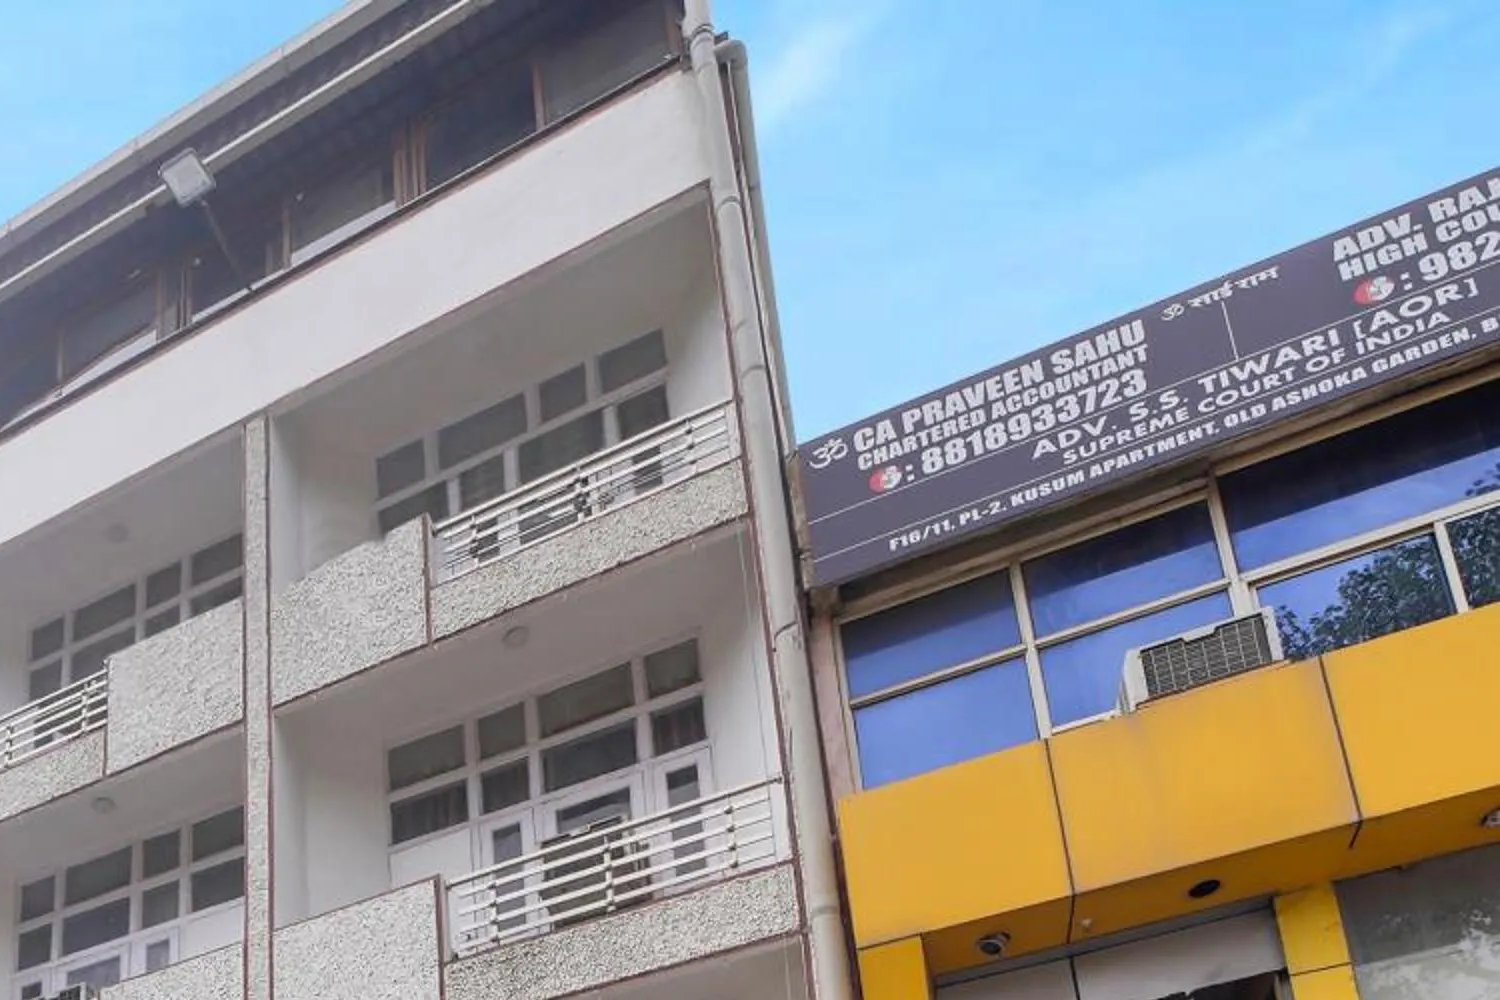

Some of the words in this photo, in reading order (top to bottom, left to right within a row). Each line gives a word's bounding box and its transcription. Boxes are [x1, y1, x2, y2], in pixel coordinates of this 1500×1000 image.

[1333, 212, 1423, 263] ADV.
[1337, 231, 1429, 282] HIGH
[853, 419, 897, 454] CA
[902, 359, 1044, 434] PRAVEEN
[1050, 319, 1146, 375] SAHU
[857, 408, 987, 471] CHARTERED
[991, 343, 1149, 420] ACCOUNTANT
[1011, 470, 1085, 507] KUSUM
[1223, 404, 1268, 429] OLD
[1271, 365, 1368, 412] ASHOKA
[1031, 415, 1118, 460] ADV.
[1197, 328, 1342, 394] TIWARI
[1062, 407, 1190, 465] SUPREME
[1197, 367, 1296, 413] COURT
[1305, 348, 1346, 373] OF
[1355, 311, 1452, 355] INDIA
